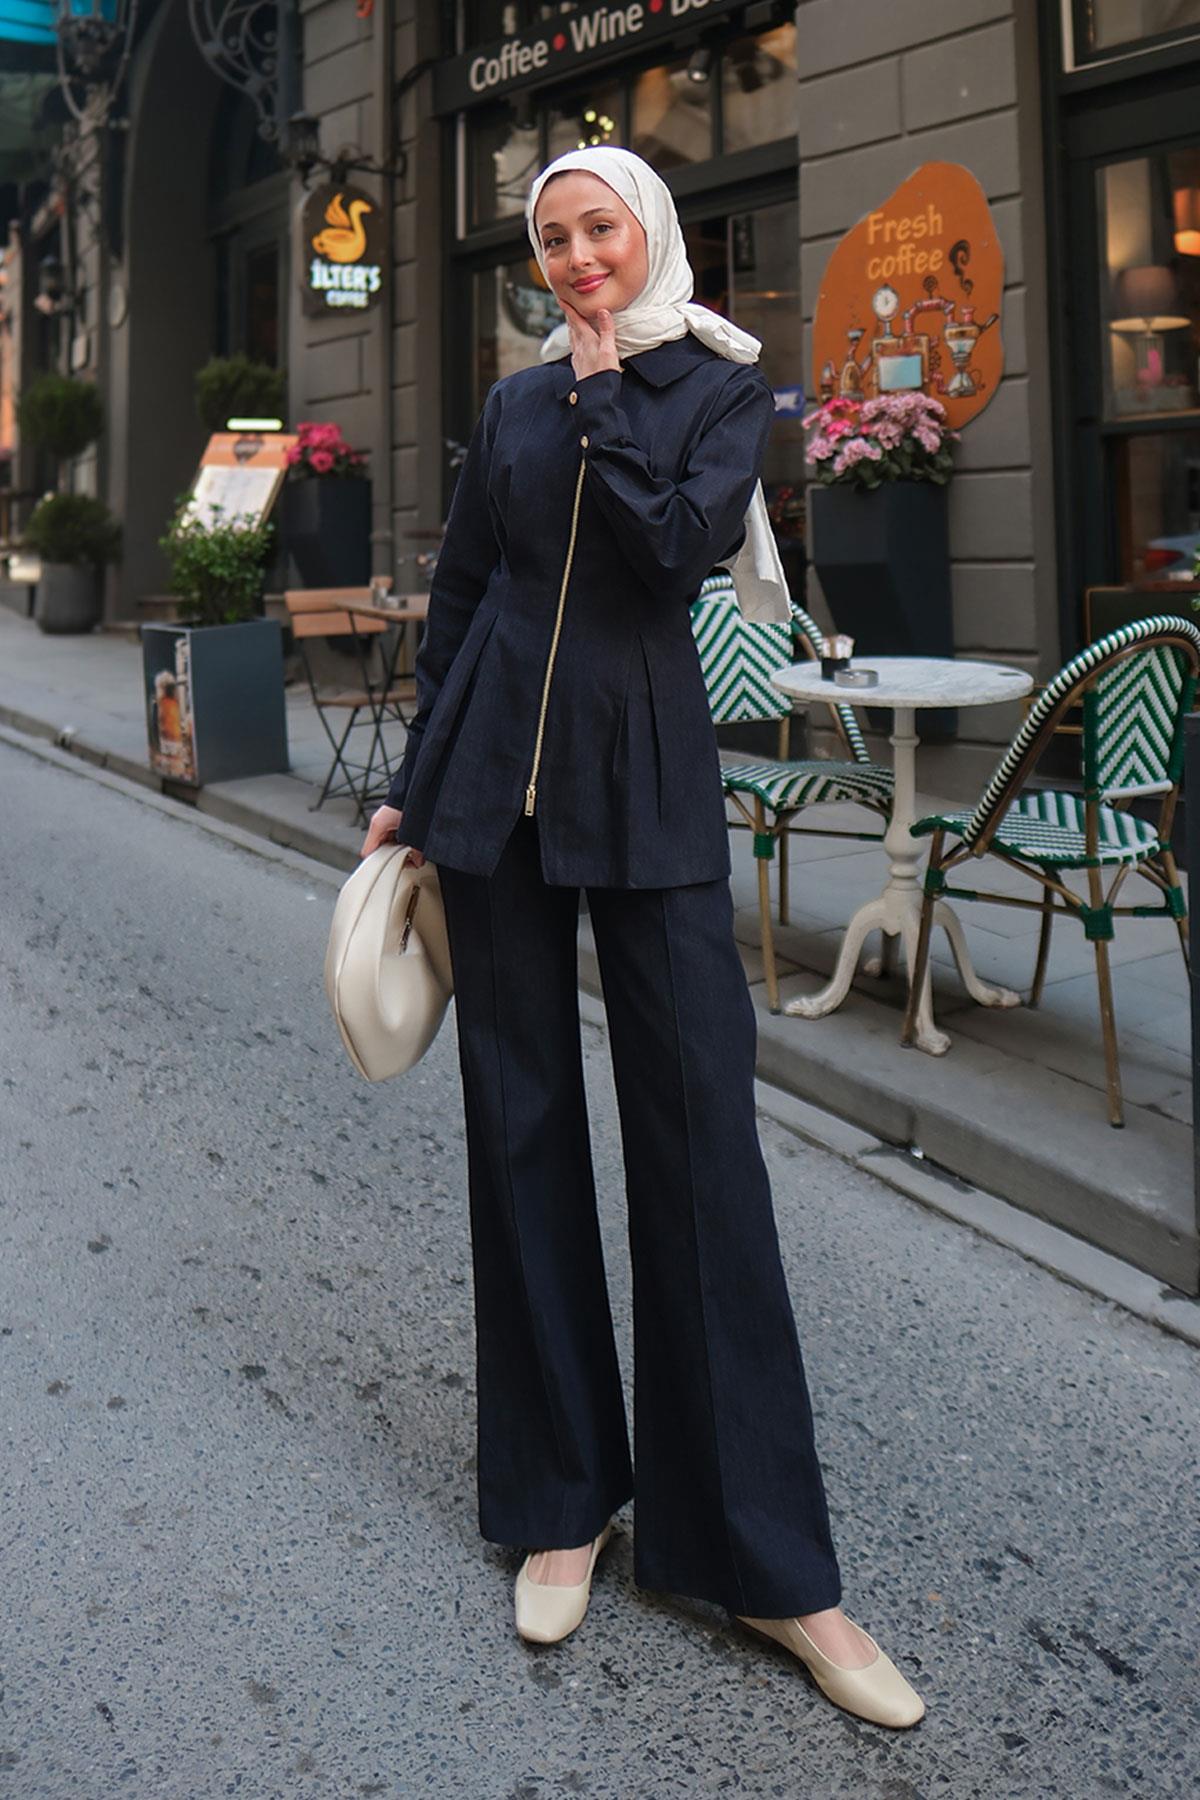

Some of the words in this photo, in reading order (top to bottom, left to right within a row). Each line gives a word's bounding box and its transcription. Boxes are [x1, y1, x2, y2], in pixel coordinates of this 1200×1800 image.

[469, 39, 549, 92] Coffee
[569, 3, 644, 53] Wine
[867, 203, 943, 245] Fresh
[867, 243, 944, 280] coffee
